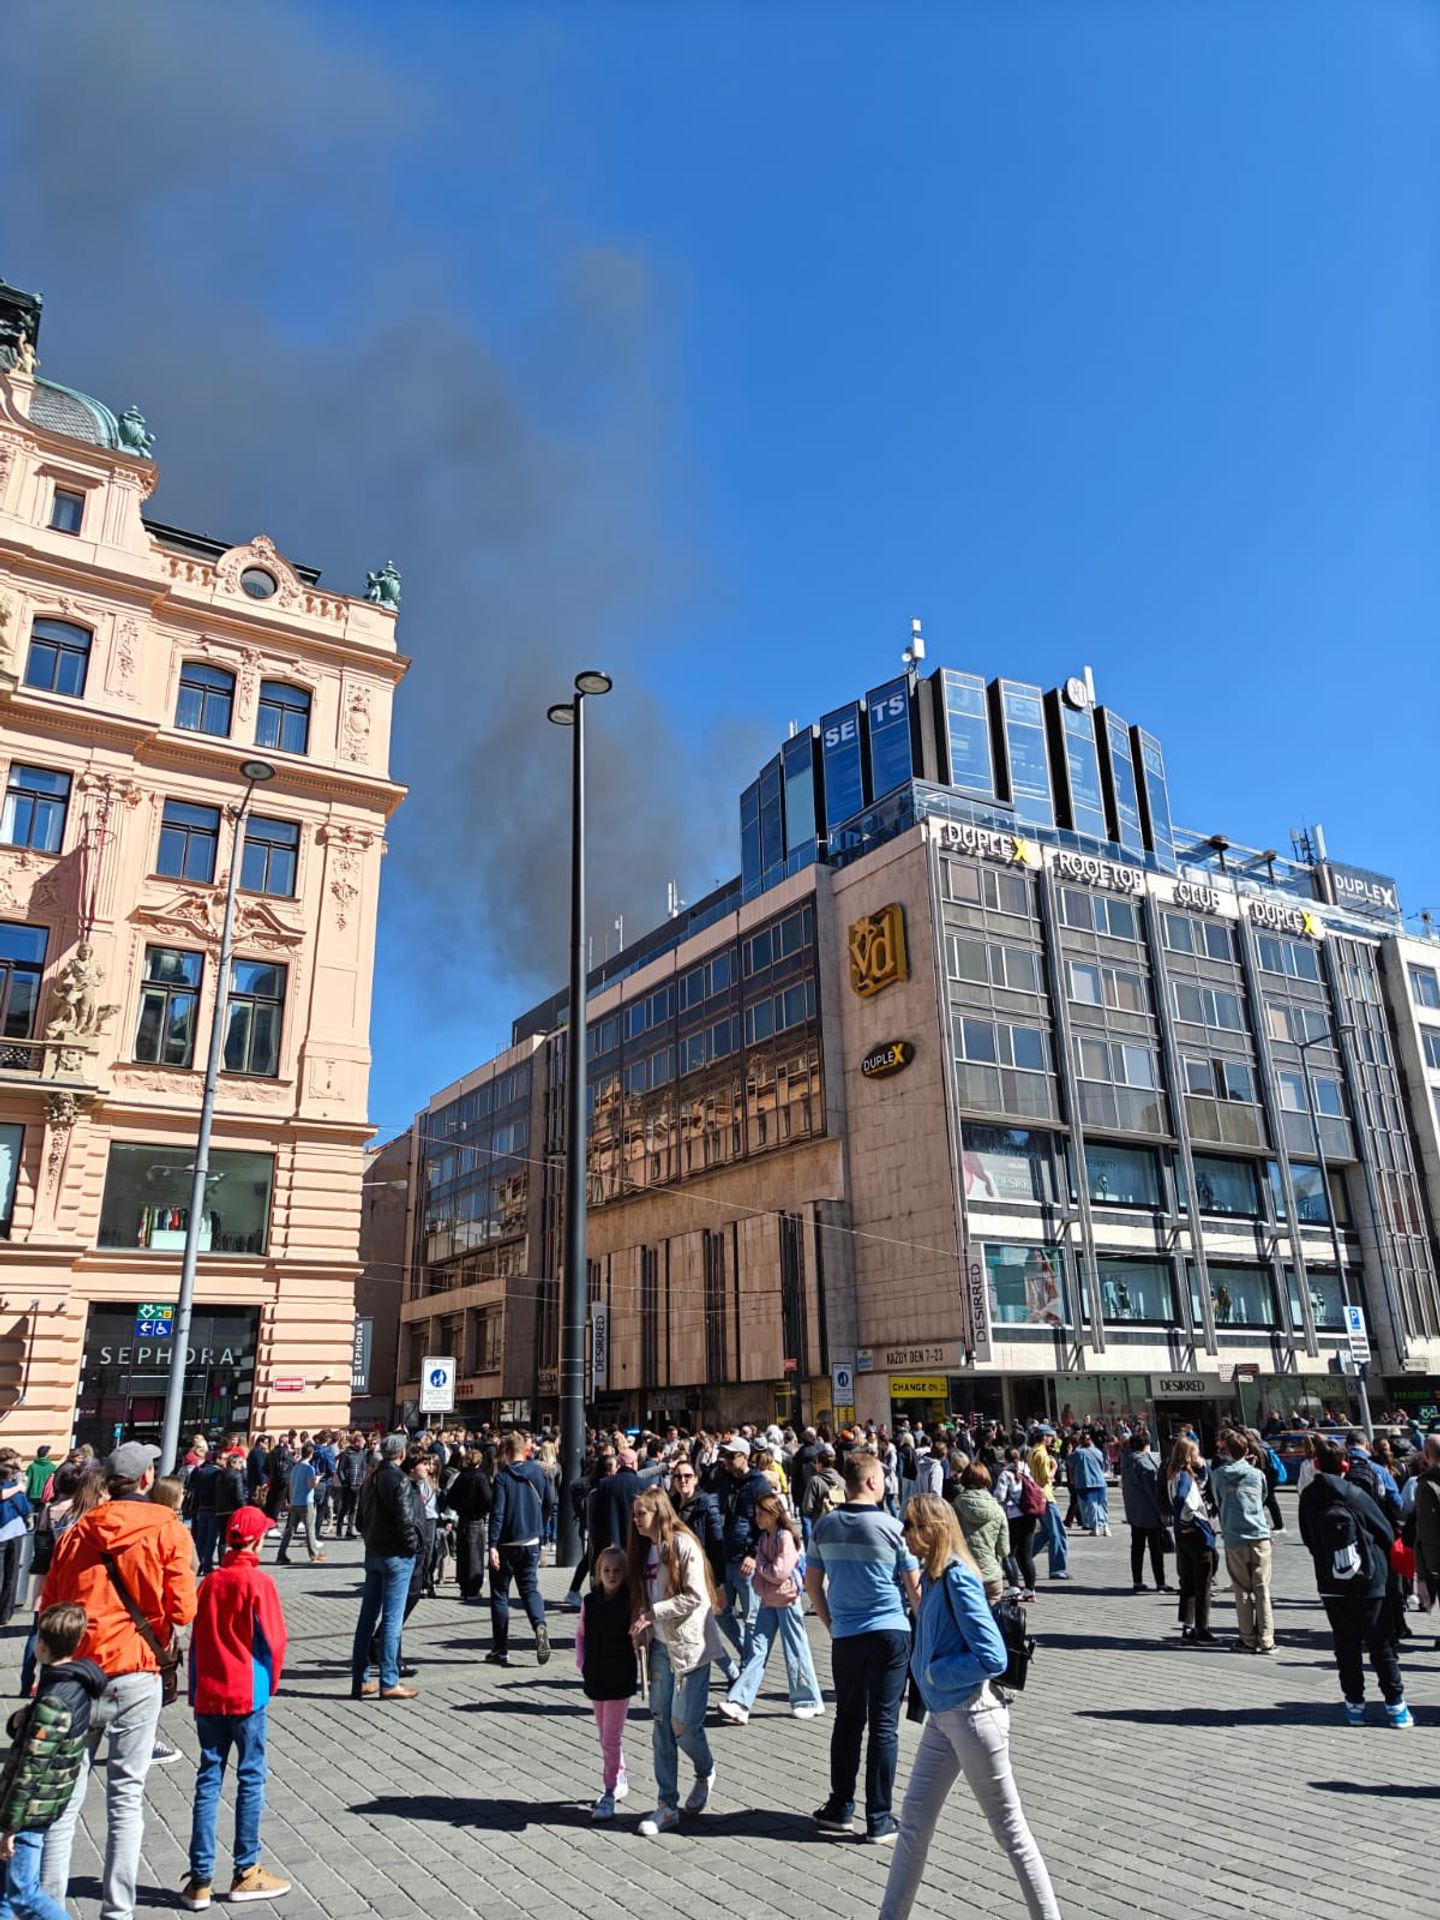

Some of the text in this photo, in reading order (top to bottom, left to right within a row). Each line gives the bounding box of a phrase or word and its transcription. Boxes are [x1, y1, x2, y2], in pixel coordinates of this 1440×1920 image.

[946, 823, 1221, 909] DUPLEX ROOFTOP CLUB
[1333, 873, 1397, 911] DUPLEX
[1253, 900, 1316, 936] DUPLEX
[863, 1043, 905, 1072] DUPLEX
[970, 1263, 987, 1342] DESIRRED
[354, 1322, 364, 1370] SEPHORA
[595, 1315, 605, 1373] DESIRRED
[909, 1350, 924, 1363] DEN
[892, 1383, 926, 1391] CHANGE
[1160, 1379, 1205, 1392] DESIRRED
